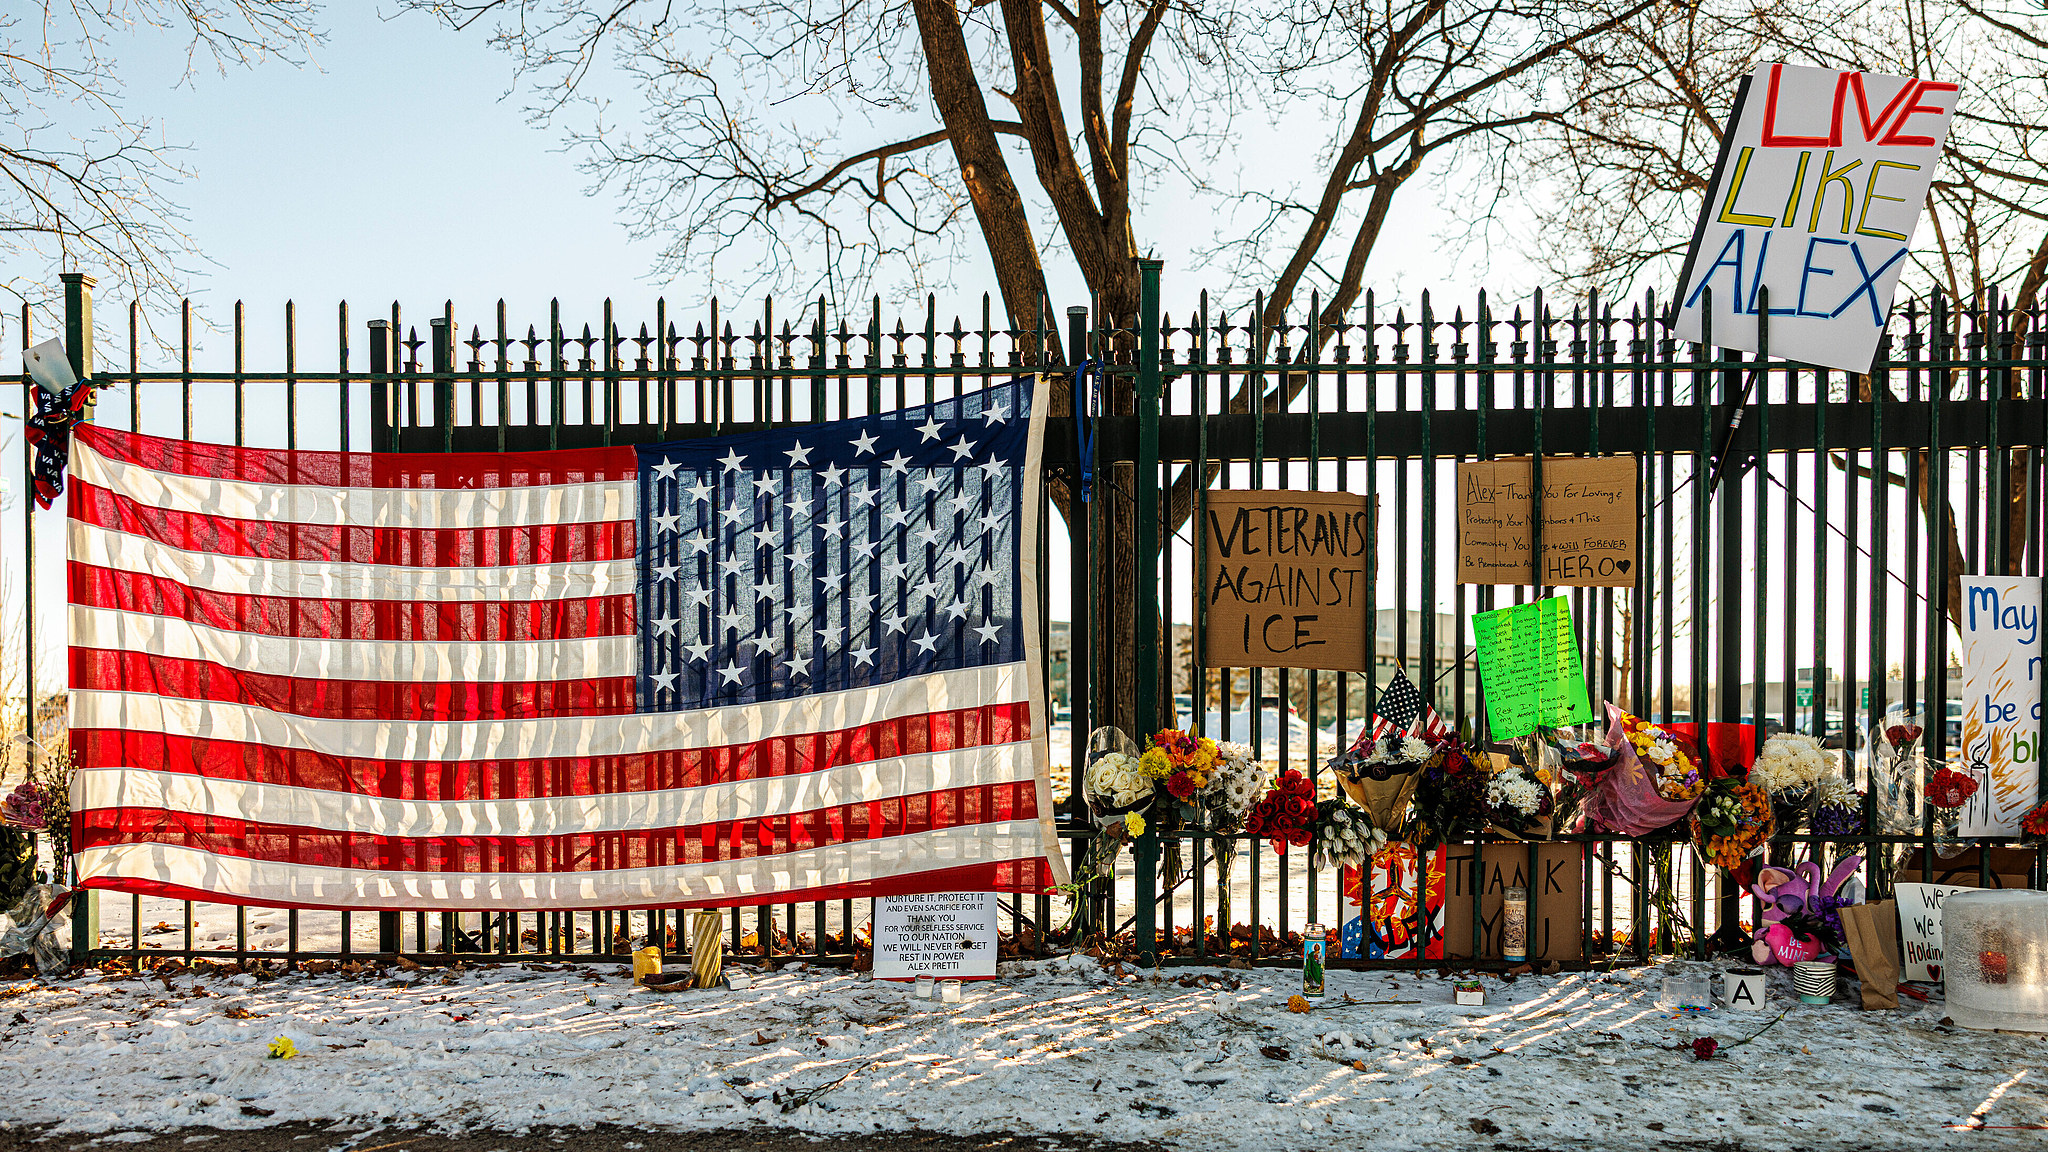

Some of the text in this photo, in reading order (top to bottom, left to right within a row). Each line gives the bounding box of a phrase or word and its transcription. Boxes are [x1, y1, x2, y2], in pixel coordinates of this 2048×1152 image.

[1761, 63, 1959, 148] LIVE
[1716, 146, 1921, 242] LIKE
[1685, 228, 1908, 327] ALEX
[34, 417, 45, 427] VA
[41, 455, 53, 465] VA
[46, 468, 58, 478] VA
[1542, 484, 1559, 499] You
[1564, 483, 1579, 498] For
[1582, 485, 1614, 504] Loving
[1506, 513, 1523, 526] Your
[1576, 511, 1600, 524] This
[1209, 506, 1367, 558] VETERANS
[1513, 537, 1530, 550] You
[1584, 537, 1627, 549] FOREVER
[1549, 554, 1615, 579] HERO
[1212, 563, 1362, 607] AGAINST
[1968, 585, 2038, 645] May
[1244, 613, 1326, 654] ICE
[1985, 693, 2018, 724] be
[885, 894, 925, 903] NURTURE
[937, 893, 975, 902] PROTECT
[977, 892, 985, 901] IT
[1920, 887, 1943, 910] We
[925, 903, 960, 911] SACRIFICE
[961, 903, 976, 911] FOR
[907, 914, 956, 923] THANK YOU
[884, 925, 899, 933] FOR
[900, 924, 920, 932] YOUR
[955, 923, 985, 931] SERVICE
[1914, 915, 1934, 938] We
[898, 932, 965, 942] TO OUR NATION
[1789, 936, 1802, 949] BE
[883, 943, 898, 952] WE
[900, 943, 921, 952] WILL
[923, 942, 952, 951] NEVER
[899, 952, 965, 962] REST IN POWER
[907, 961, 959, 971] ALEX PRETTI
[1732, 979, 1755, 1005] A
